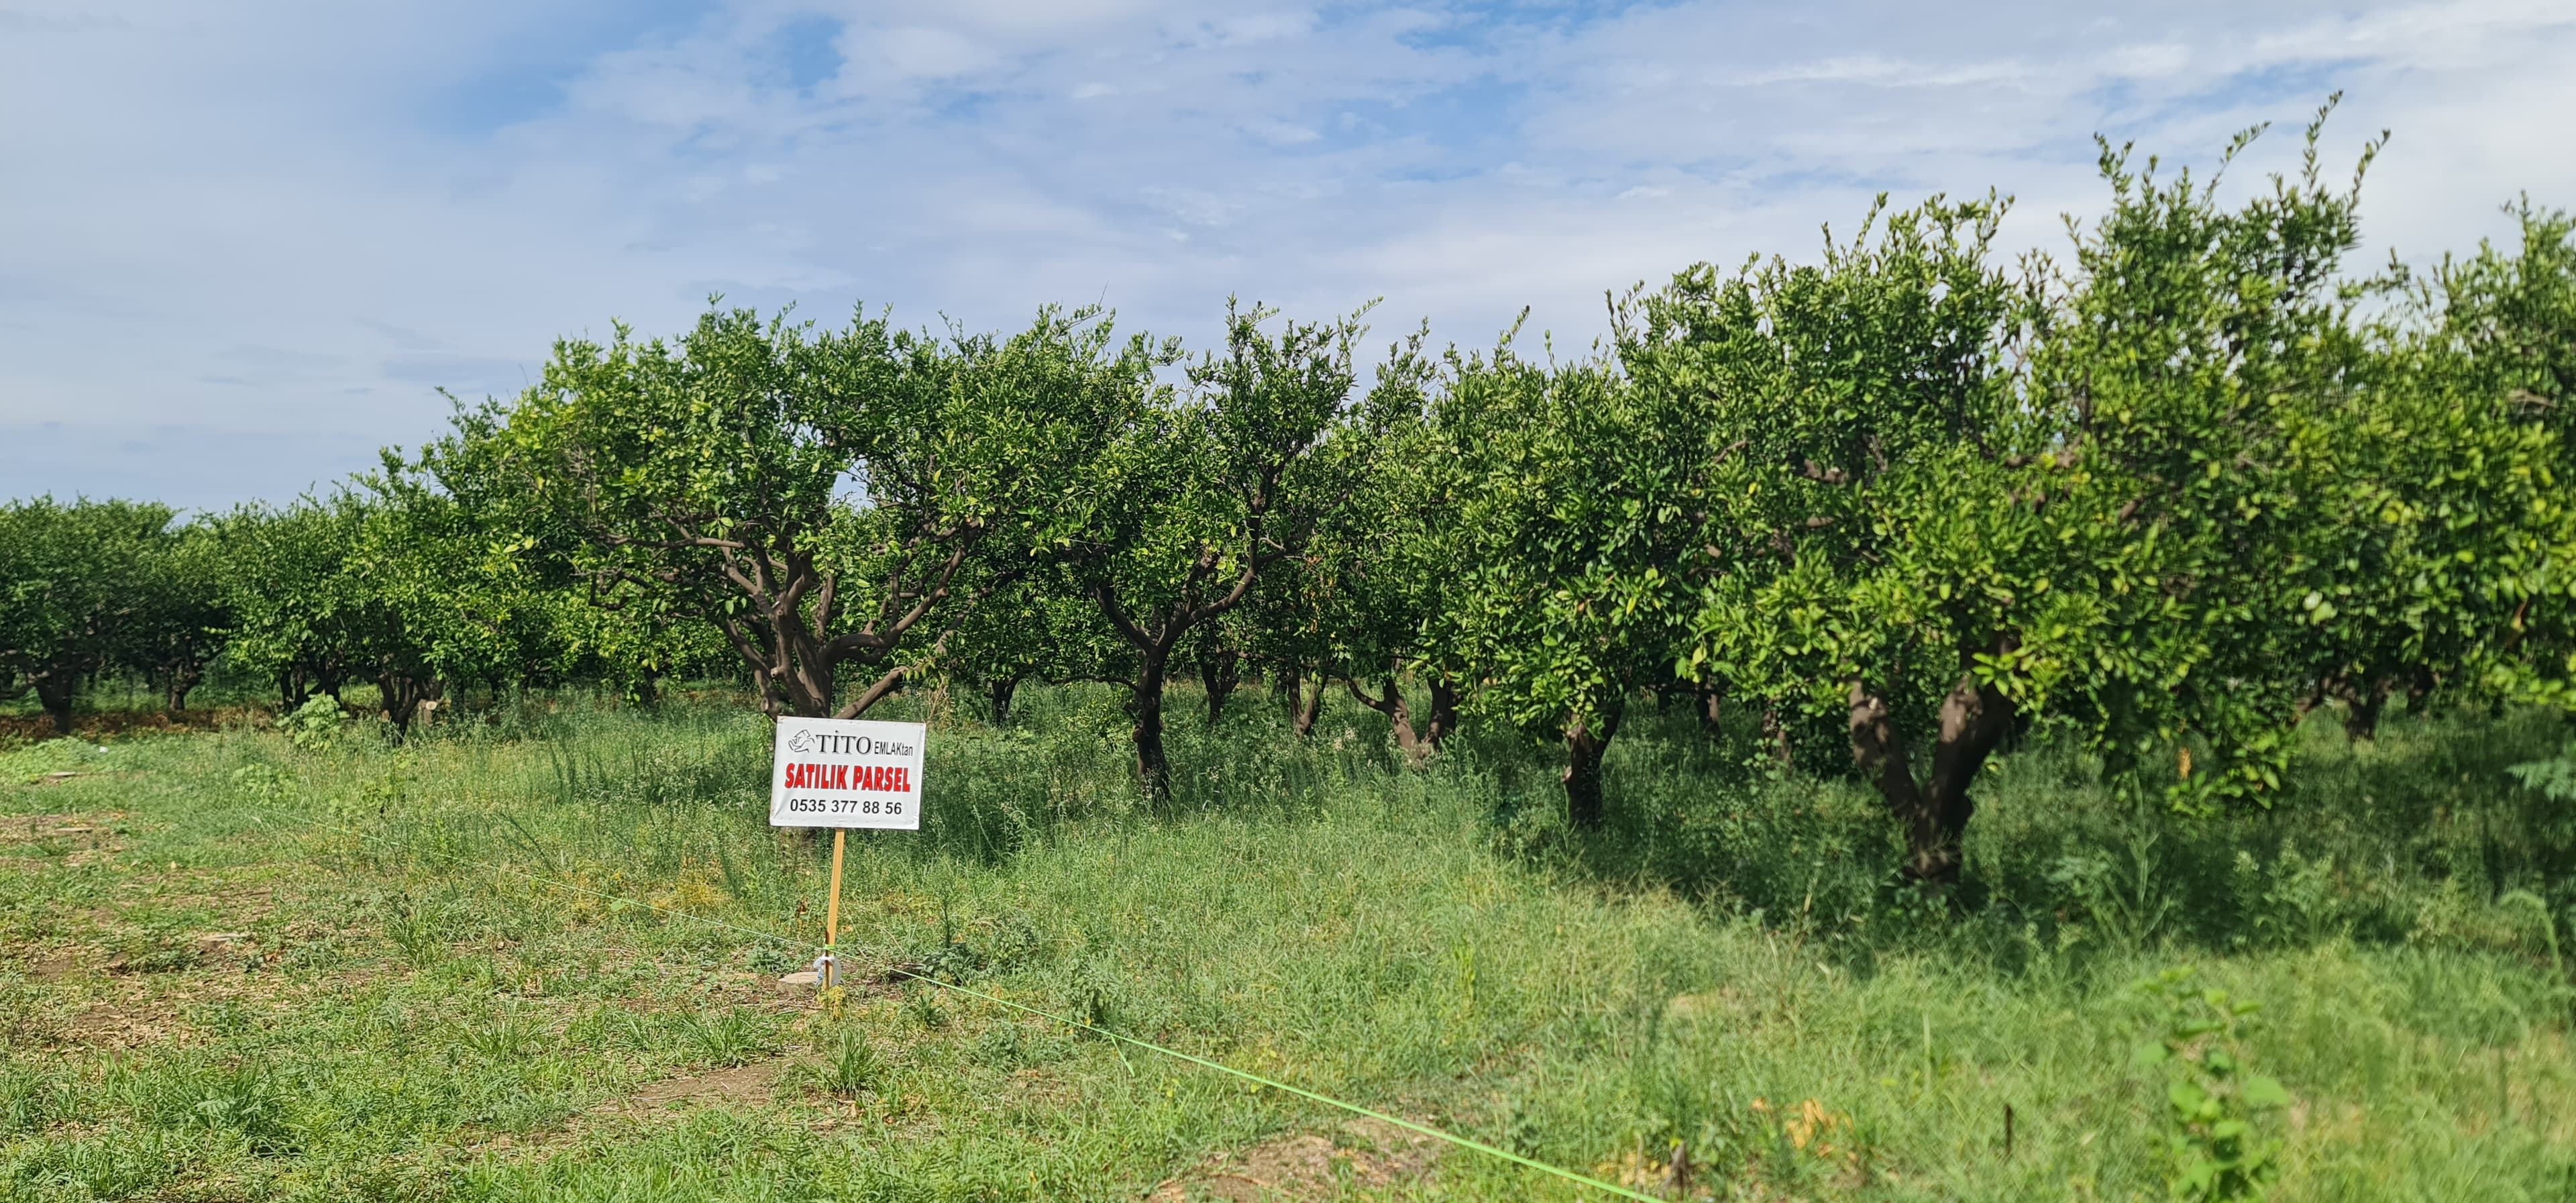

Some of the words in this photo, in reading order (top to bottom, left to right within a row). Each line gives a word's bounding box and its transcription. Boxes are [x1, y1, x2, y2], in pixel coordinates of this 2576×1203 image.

[816, 730, 872, 755] TİTO
[874, 741, 913, 756] EMLAKtan
[784, 763, 849, 790] SATILIK
[853, 765, 911, 792] PARSEL
[790, 798, 826, 812] 0535
[831, 800, 857, 813] 377
[863, 801, 879, 814] 88
[885, 802, 902, 815] 56
